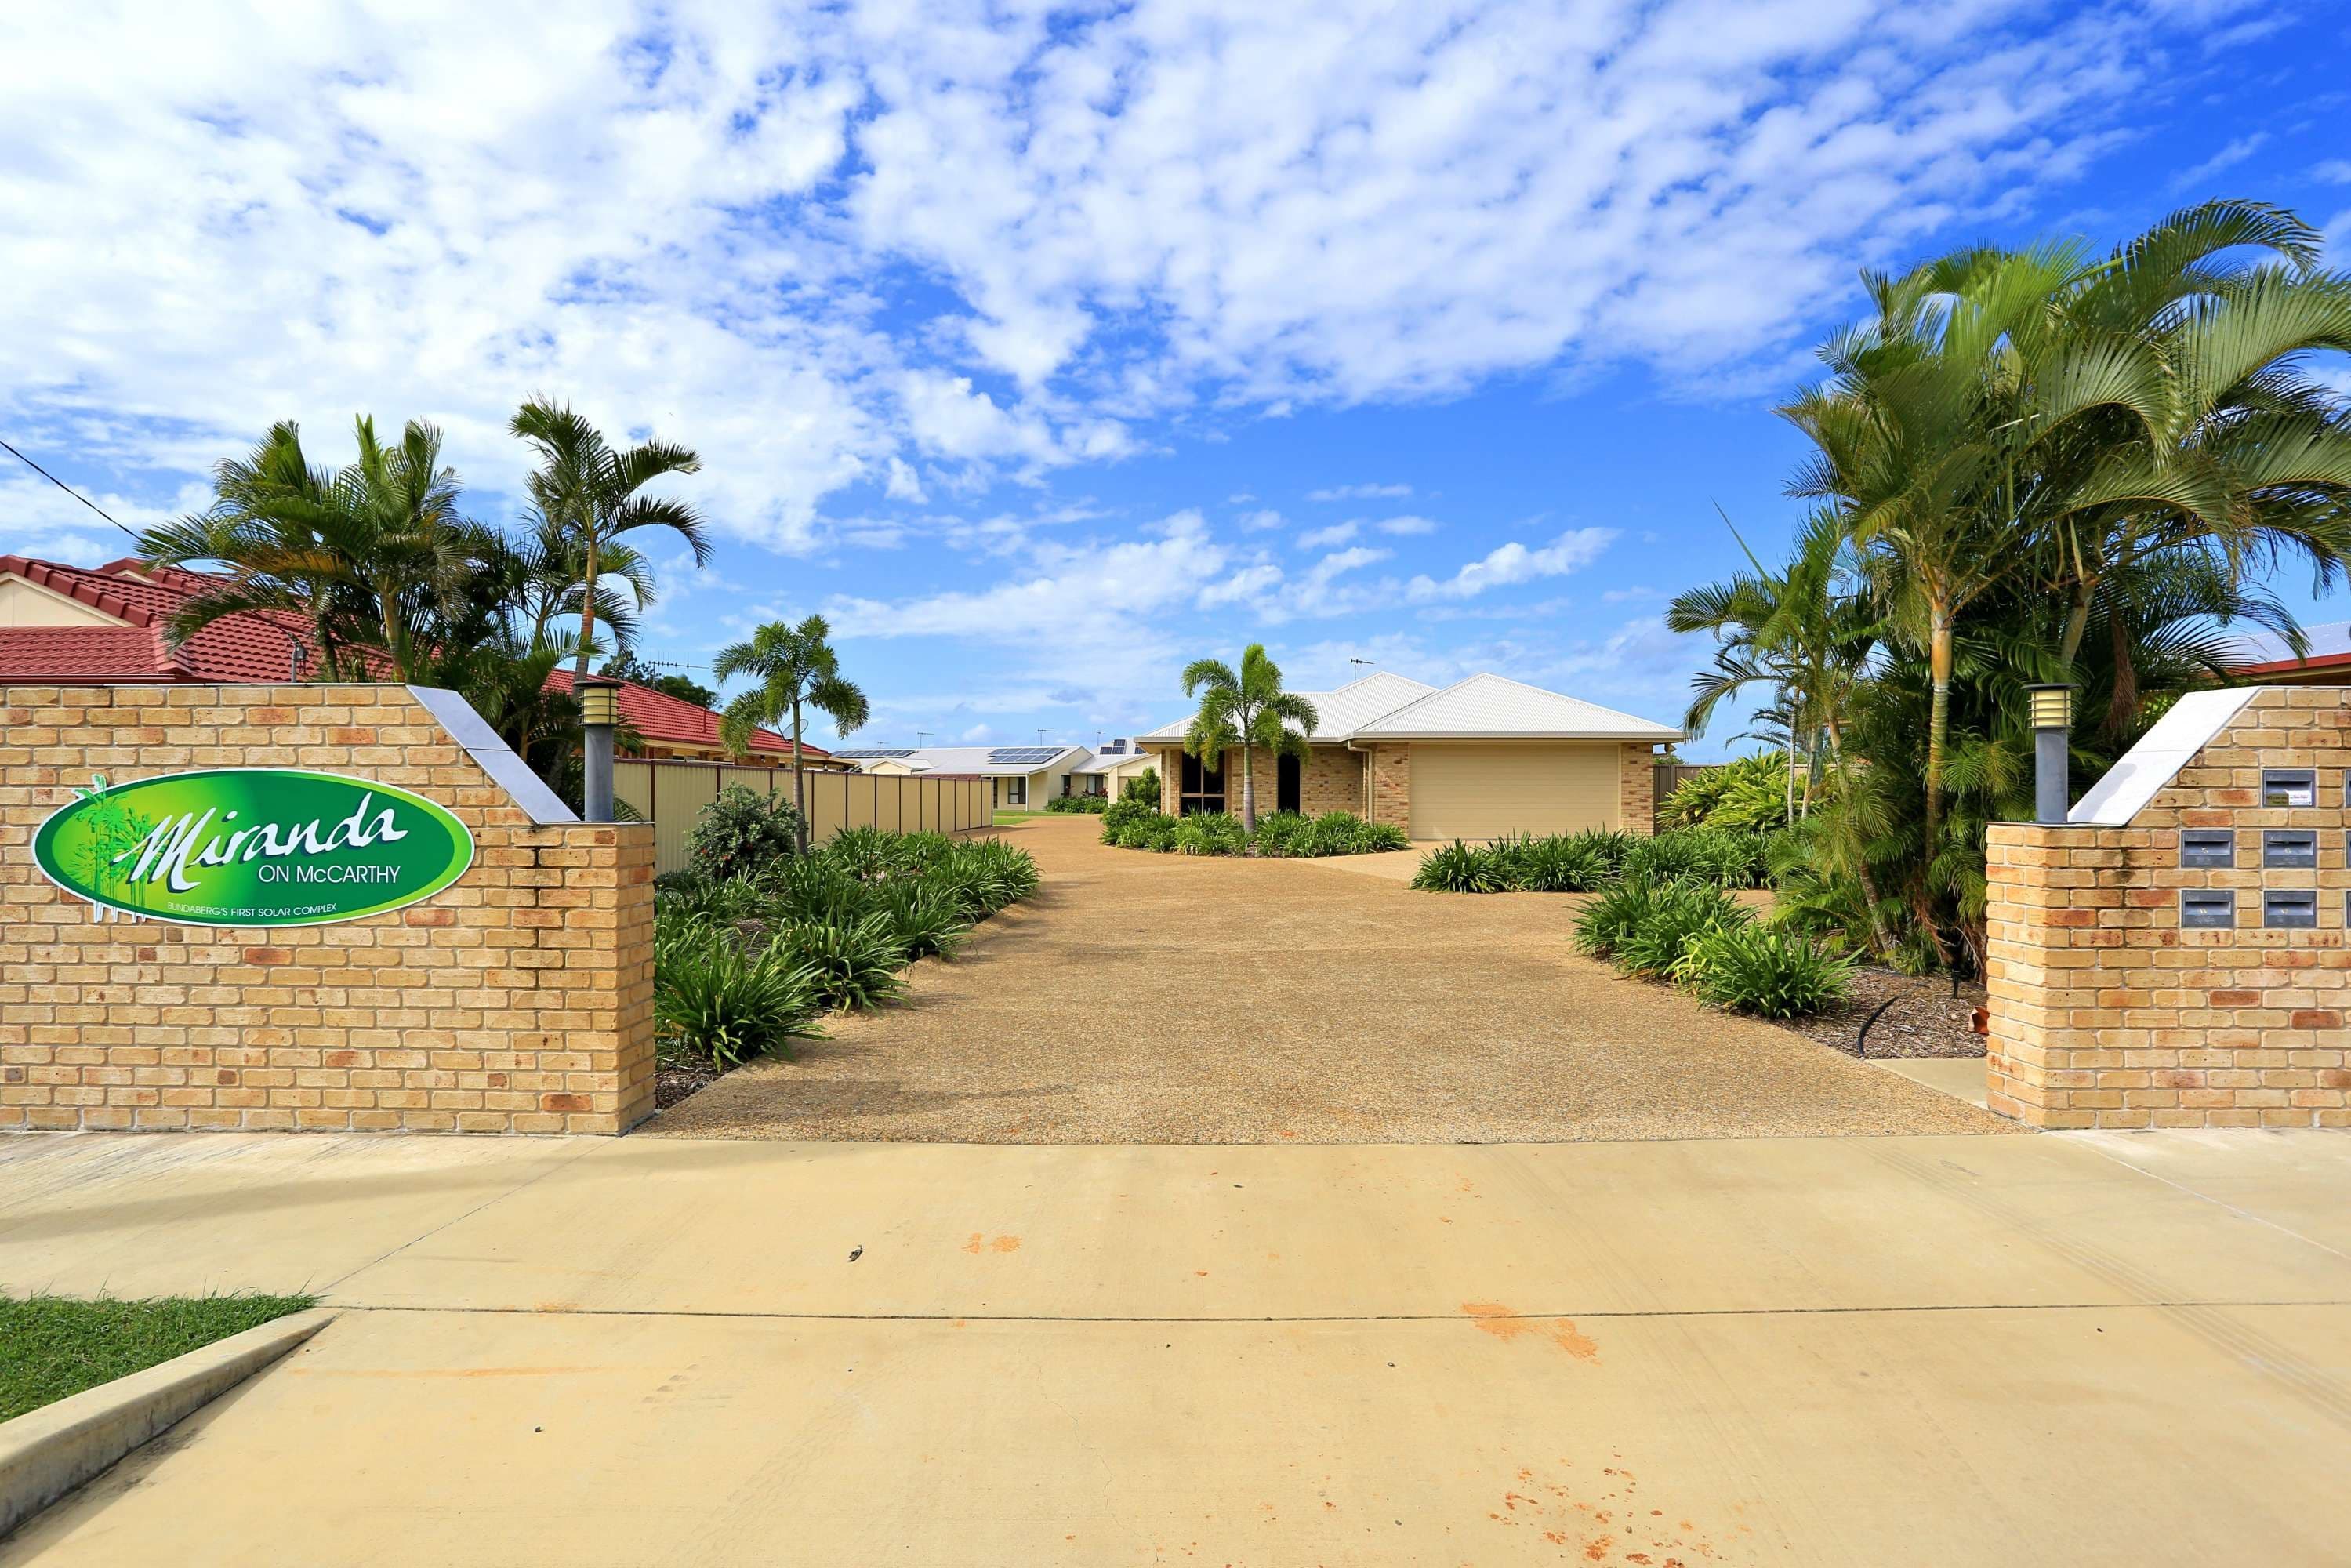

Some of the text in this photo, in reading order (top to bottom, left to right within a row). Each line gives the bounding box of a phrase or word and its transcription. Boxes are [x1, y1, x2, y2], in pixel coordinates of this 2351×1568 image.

[113, 791, 408, 891] Miranda
[258, 864, 401, 884] ON McCARTHY
[167, 902, 337, 916] BUNDABERG'S FIRST SOLAR COMPLEX
